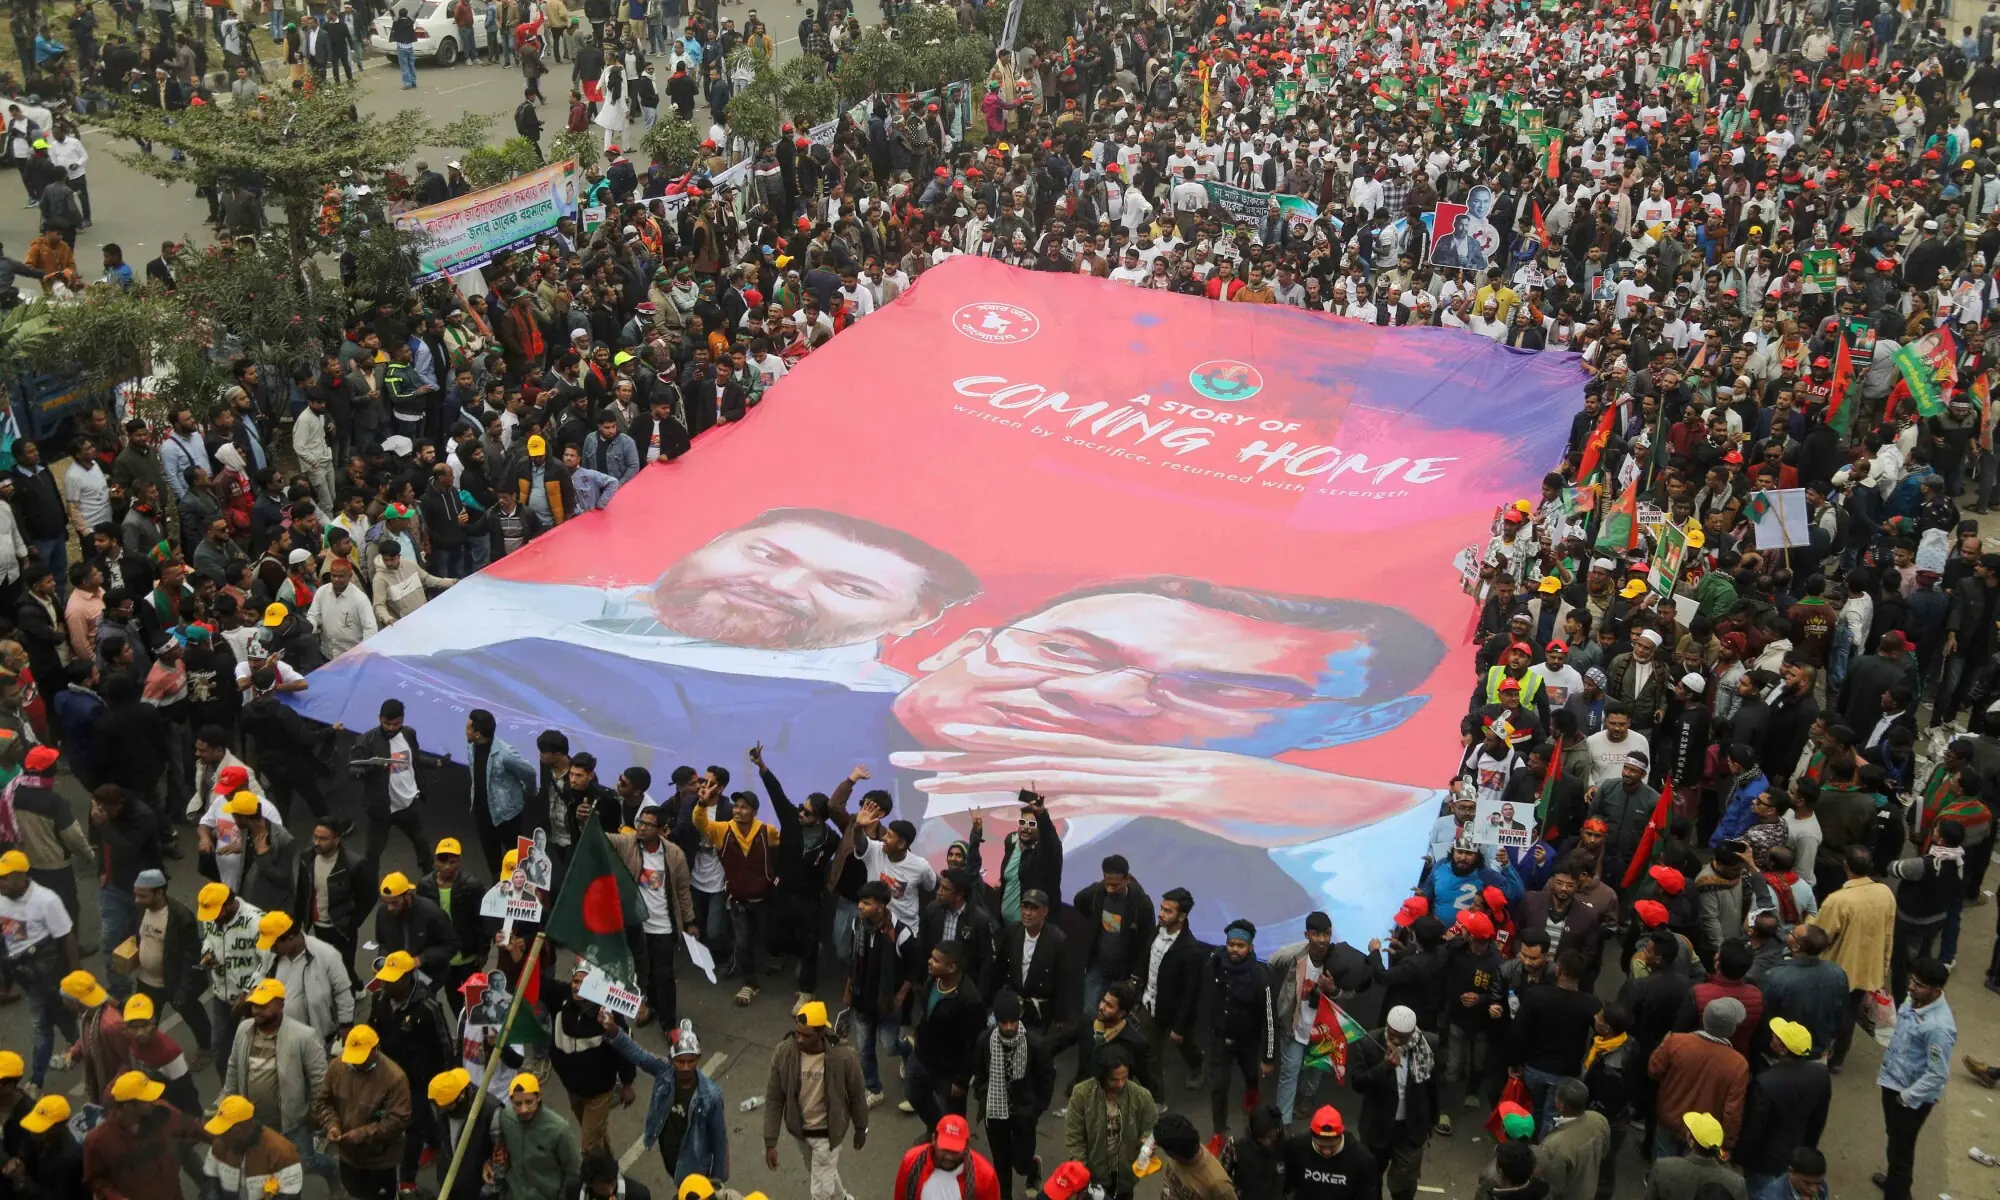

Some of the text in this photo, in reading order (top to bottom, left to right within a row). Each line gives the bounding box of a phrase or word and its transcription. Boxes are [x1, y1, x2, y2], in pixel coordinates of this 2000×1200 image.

[425, 211, 462, 233] বাংলাদেশ
[464, 190, 513, 220] জাতীয়তাবাদী
[1128, 393, 1302, 434] A STORY OF
[952, 375, 1460, 486] COMING HOME
[953, 403, 1409, 500] written by sacrifice, returned with strength
[1640, 515, 1662, 523] HOME
[1498, 829, 1528, 837] WELCOME
[1498, 835, 1528, 846] HOME
[507, 900, 538, 909] WELCOME
[1453, 883, 1478, 910] 2
[506, 908, 537, 920] HOME
[226, 956, 253, 969] STAY
[608, 986, 640, 1003] WELCOME
[605, 993, 637, 1015] HOME
[1304, 1168, 1347, 1186] POKER
